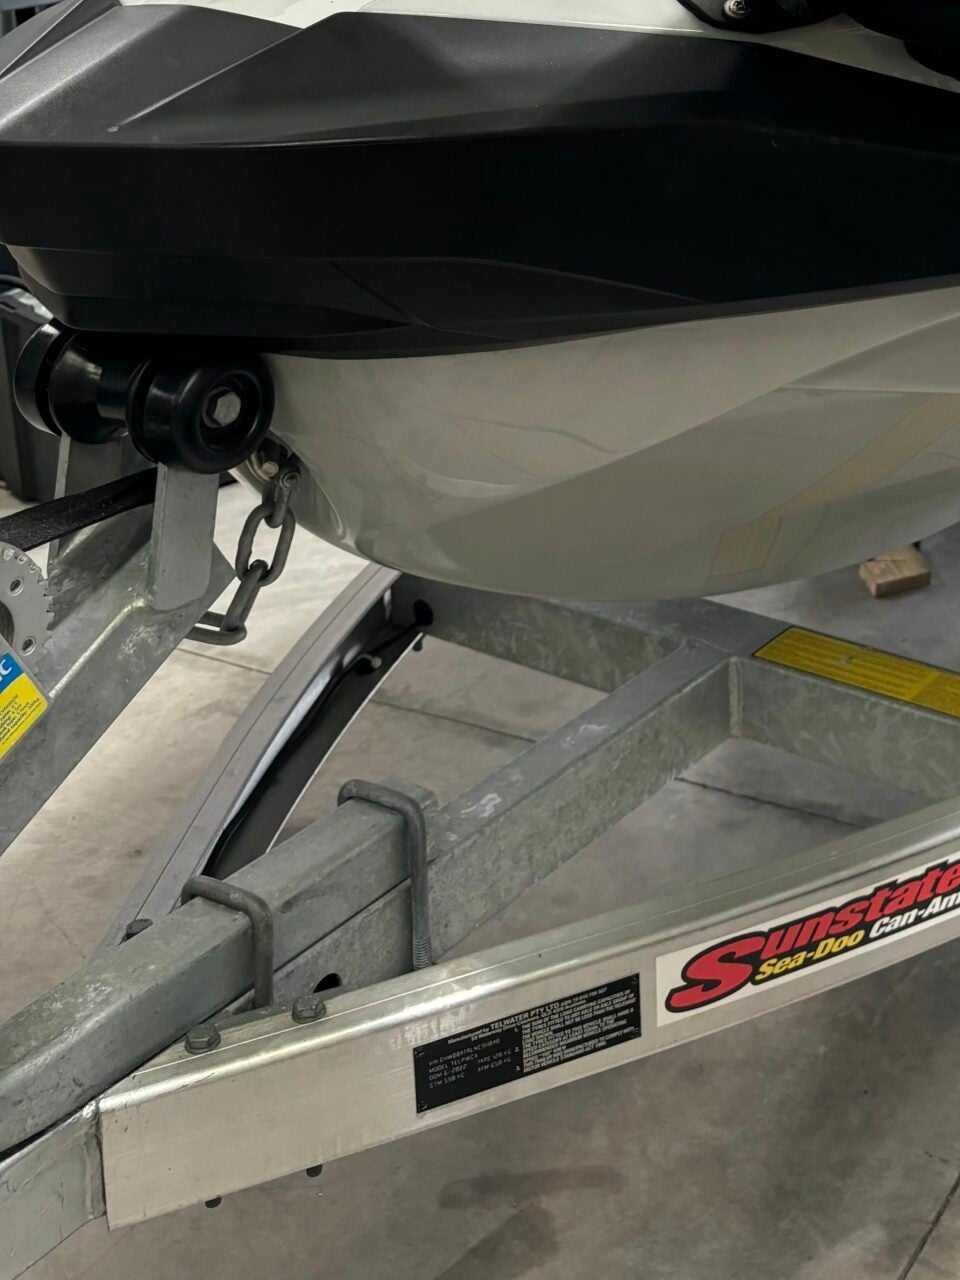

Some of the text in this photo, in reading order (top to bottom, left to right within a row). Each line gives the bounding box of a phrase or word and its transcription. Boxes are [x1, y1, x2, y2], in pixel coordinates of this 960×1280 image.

[755, 930, 865, 981] Sea-Doo
[490, 1011, 528, 1030] TELWATER
[530, 1006, 544, 1016] PTY
[545, 1001, 559, 1011] LTD
